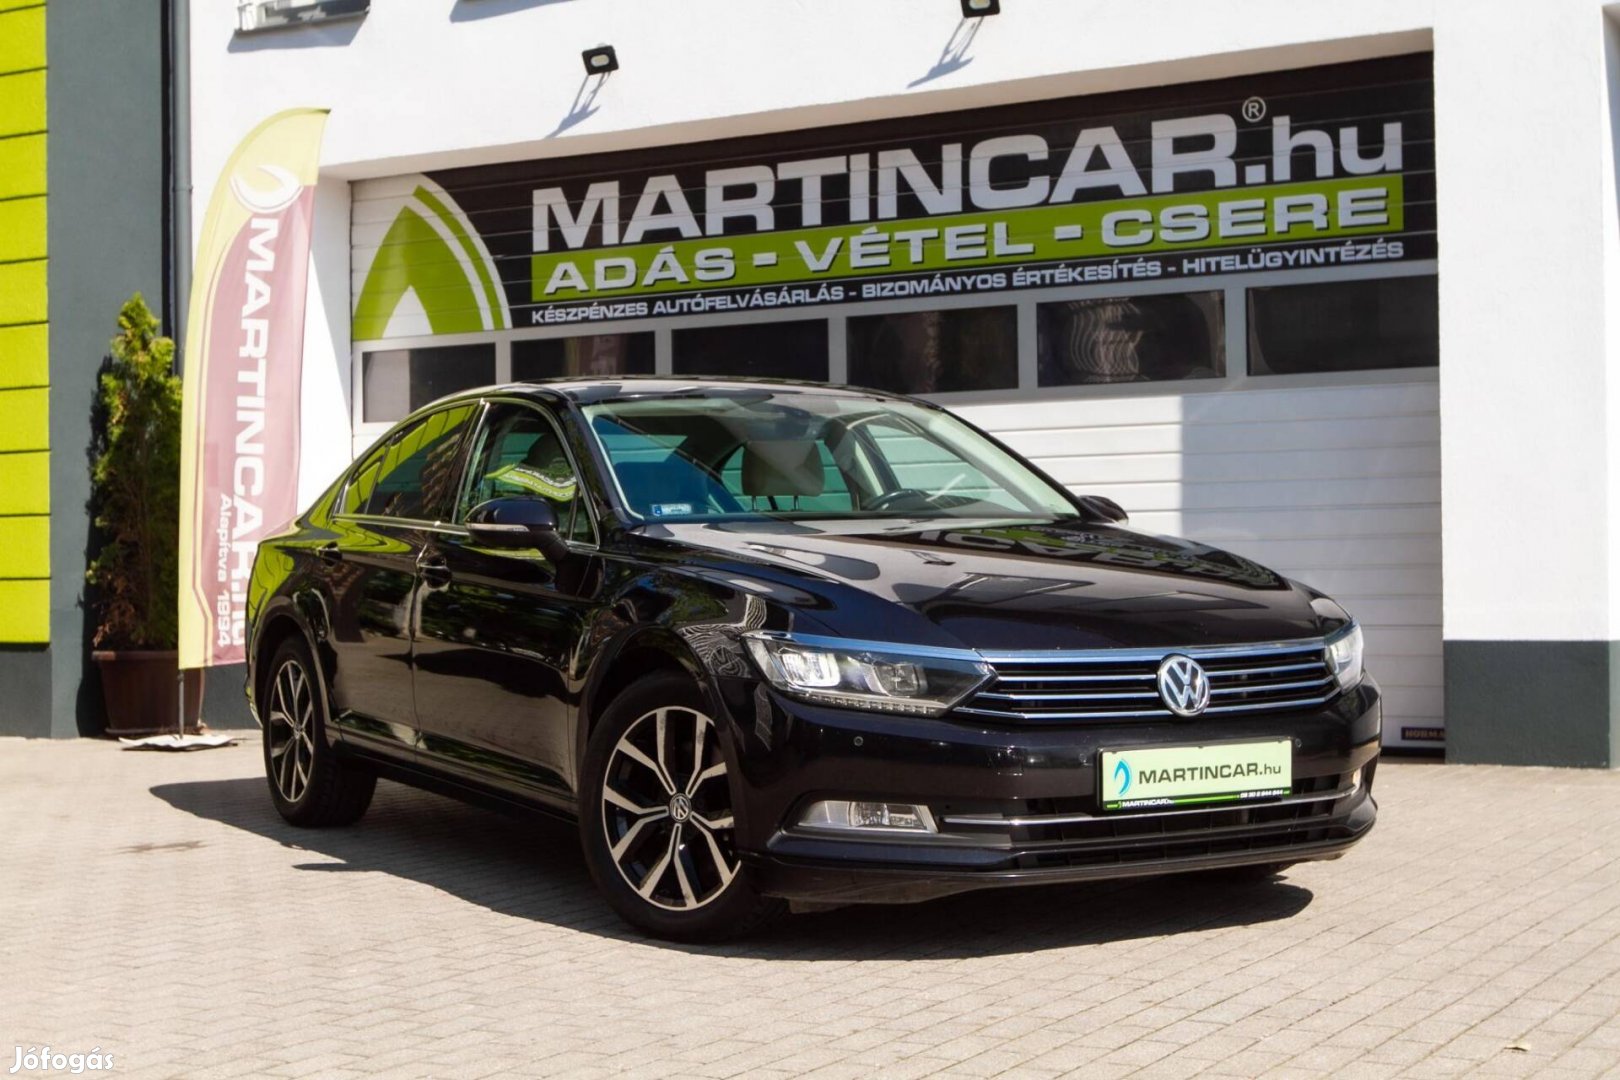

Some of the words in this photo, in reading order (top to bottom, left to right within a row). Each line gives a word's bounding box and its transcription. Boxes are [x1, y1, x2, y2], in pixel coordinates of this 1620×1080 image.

[532, 301, 648, 324] KÉSZPÉNZES
[652, 284, 845, 316] AUTÓFELVÁSÁRLÁS
[862, 272, 1006, 299] BIZOMÁNYOS
[1012, 258, 1162, 287] ÉRTÉKESÍTÉS
[1183, 238, 1403, 273] HITELÜGYINTÉZÉS
[543, 245, 737, 295] ADÁS
[795, 222, 1034, 272] VÉTEL
[1101, 187, 1389, 247] CSERE
[1139, 763, 1282, 785] MARTINCAR.hu
